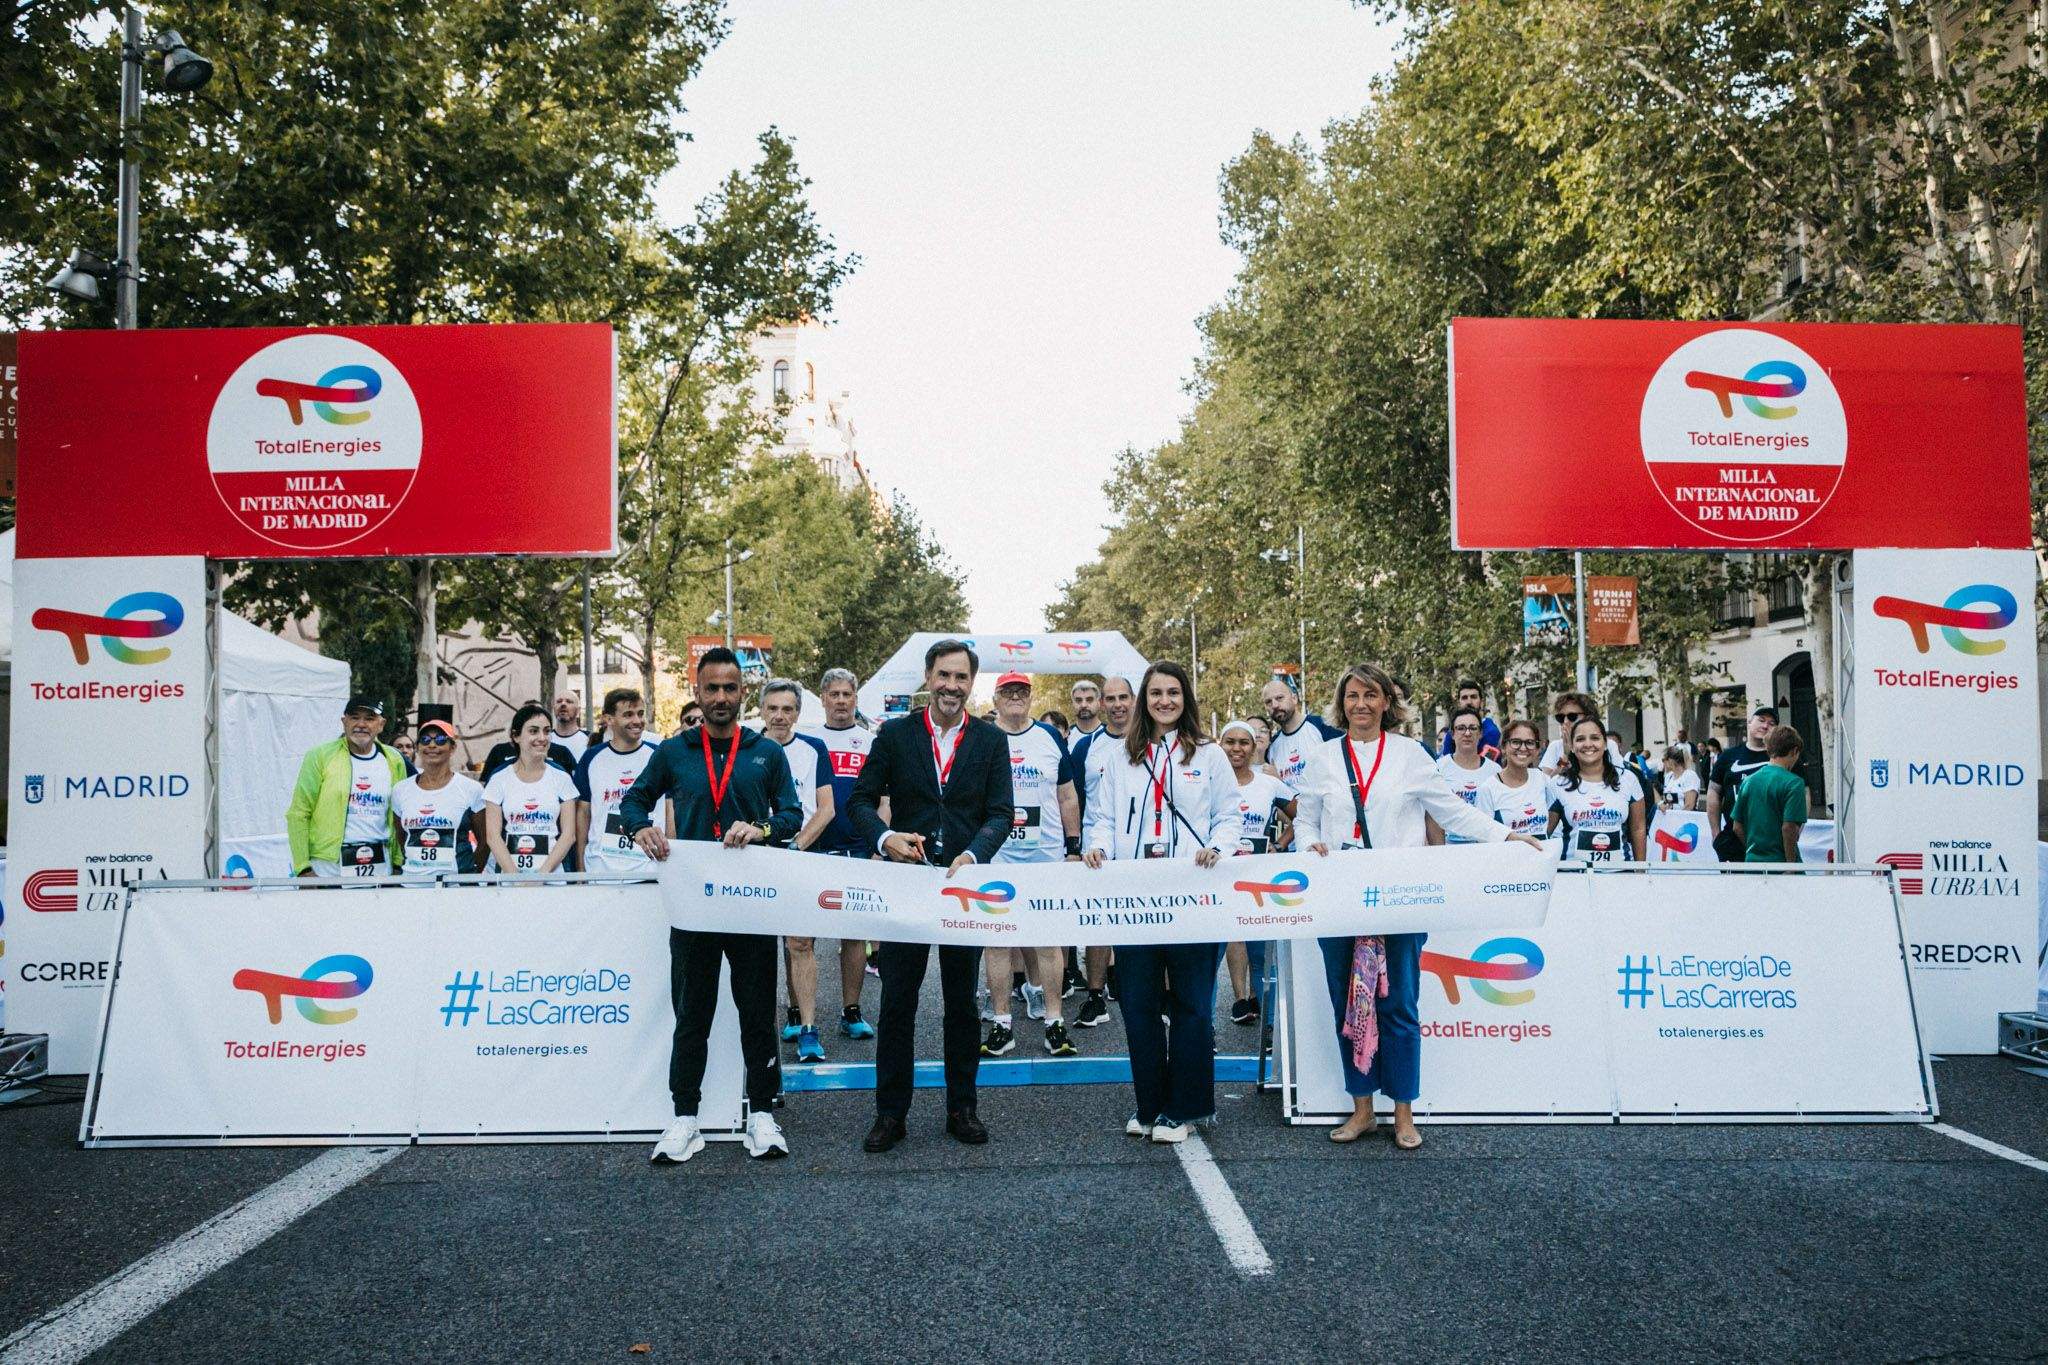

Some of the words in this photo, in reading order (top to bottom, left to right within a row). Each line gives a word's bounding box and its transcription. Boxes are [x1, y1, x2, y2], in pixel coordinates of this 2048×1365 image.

[255, 438, 381, 457] TotalEnergies
[1687, 431, 1809, 450] TotalEnergies
[285, 476, 345, 492] MILLA
[1719, 469, 1777, 484] MILLA
[1698, 506, 1723, 520] DE
[1728, 506, 1799, 521] MADRID
[262, 515, 288, 529] DE
[293, 514, 367, 529] MADRID
[1526, 584, 1548, 592] ISLA
[1874, 669, 2019, 693] TotalEnergies
[31, 680, 184, 703] TotalEnergies
[1909, 763, 2024, 786] MADRID
[66, 775, 189, 798] MADRID
[618, 836, 634, 850] 64
[1929, 841, 1949, 849] new
[1952, 840, 1992, 849] balance
[85, 855, 106, 863] new
[109, 853, 153, 863] balance
[421, 848, 437, 861] 58
[517, 855, 534, 869] 93
[1590, 851, 1611, 861] 129
[1931, 854, 2008, 872] MILLA
[355, 865, 375, 877] 122
[722, 885, 777, 899] MADRID
[1931, 877, 2020, 896] URBANA
[1029, 898, 1081, 911] MILLA
[941, 918, 1017, 933] TotalEnergies
[1079, 914, 1102, 926] DE
[1107, 912, 1173, 926] MADRID
[1236, 914, 1314, 926] TotalEnergies
[1660, 983, 1797, 1009] LasCarreras
[487, 999, 630, 1025] LasCarreras
[1419, 1020, 1551, 1042] otalEnergies
[1659, 1026, 1764, 1040] totalenergies.es
[224, 1039, 367, 1062] TotalEnergies
[476, 1043, 588, 1058] totalenergies.es
